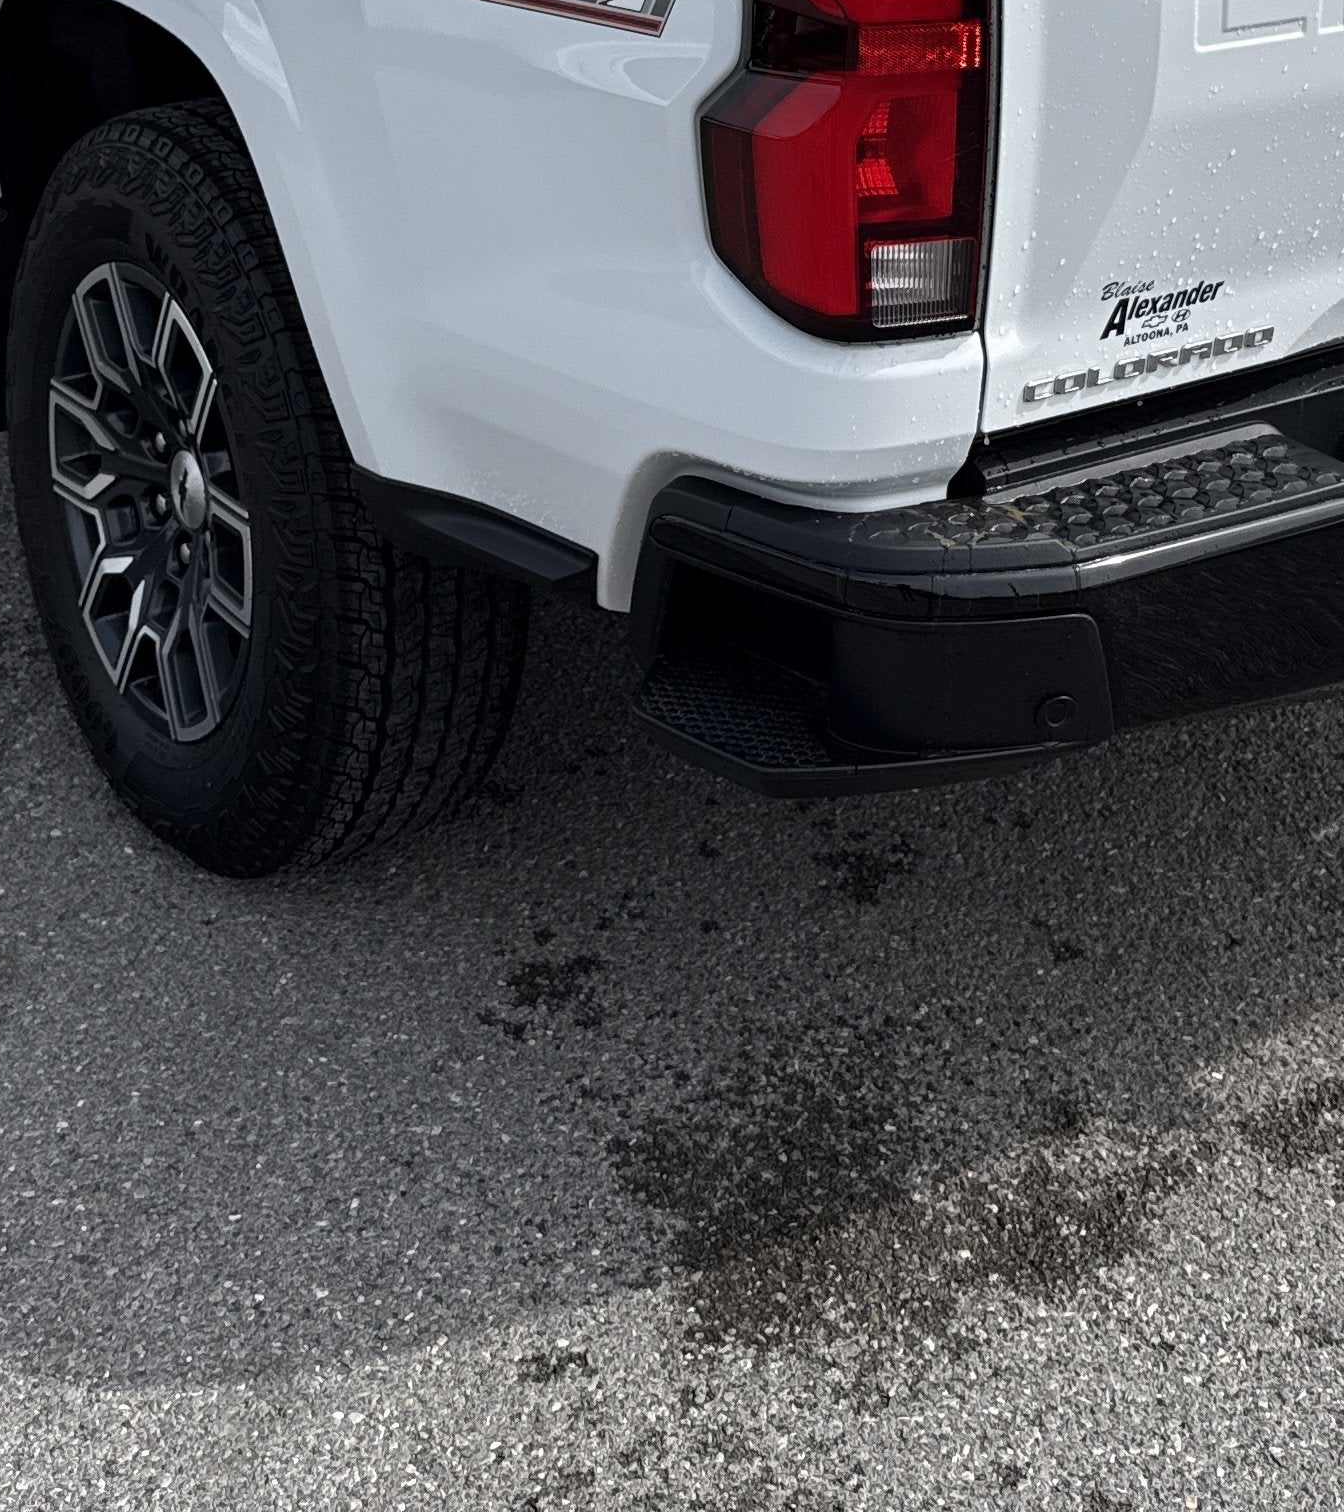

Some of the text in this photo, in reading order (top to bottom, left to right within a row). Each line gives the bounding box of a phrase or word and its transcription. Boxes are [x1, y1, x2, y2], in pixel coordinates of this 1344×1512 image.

[1099, 280, 1225, 340] Alexander
[1100, 279, 1156, 302] Blaise
[1123, 322, 1189, 347] ALTOONA, PA
[1022, 324, 1275, 403] COLORADO
